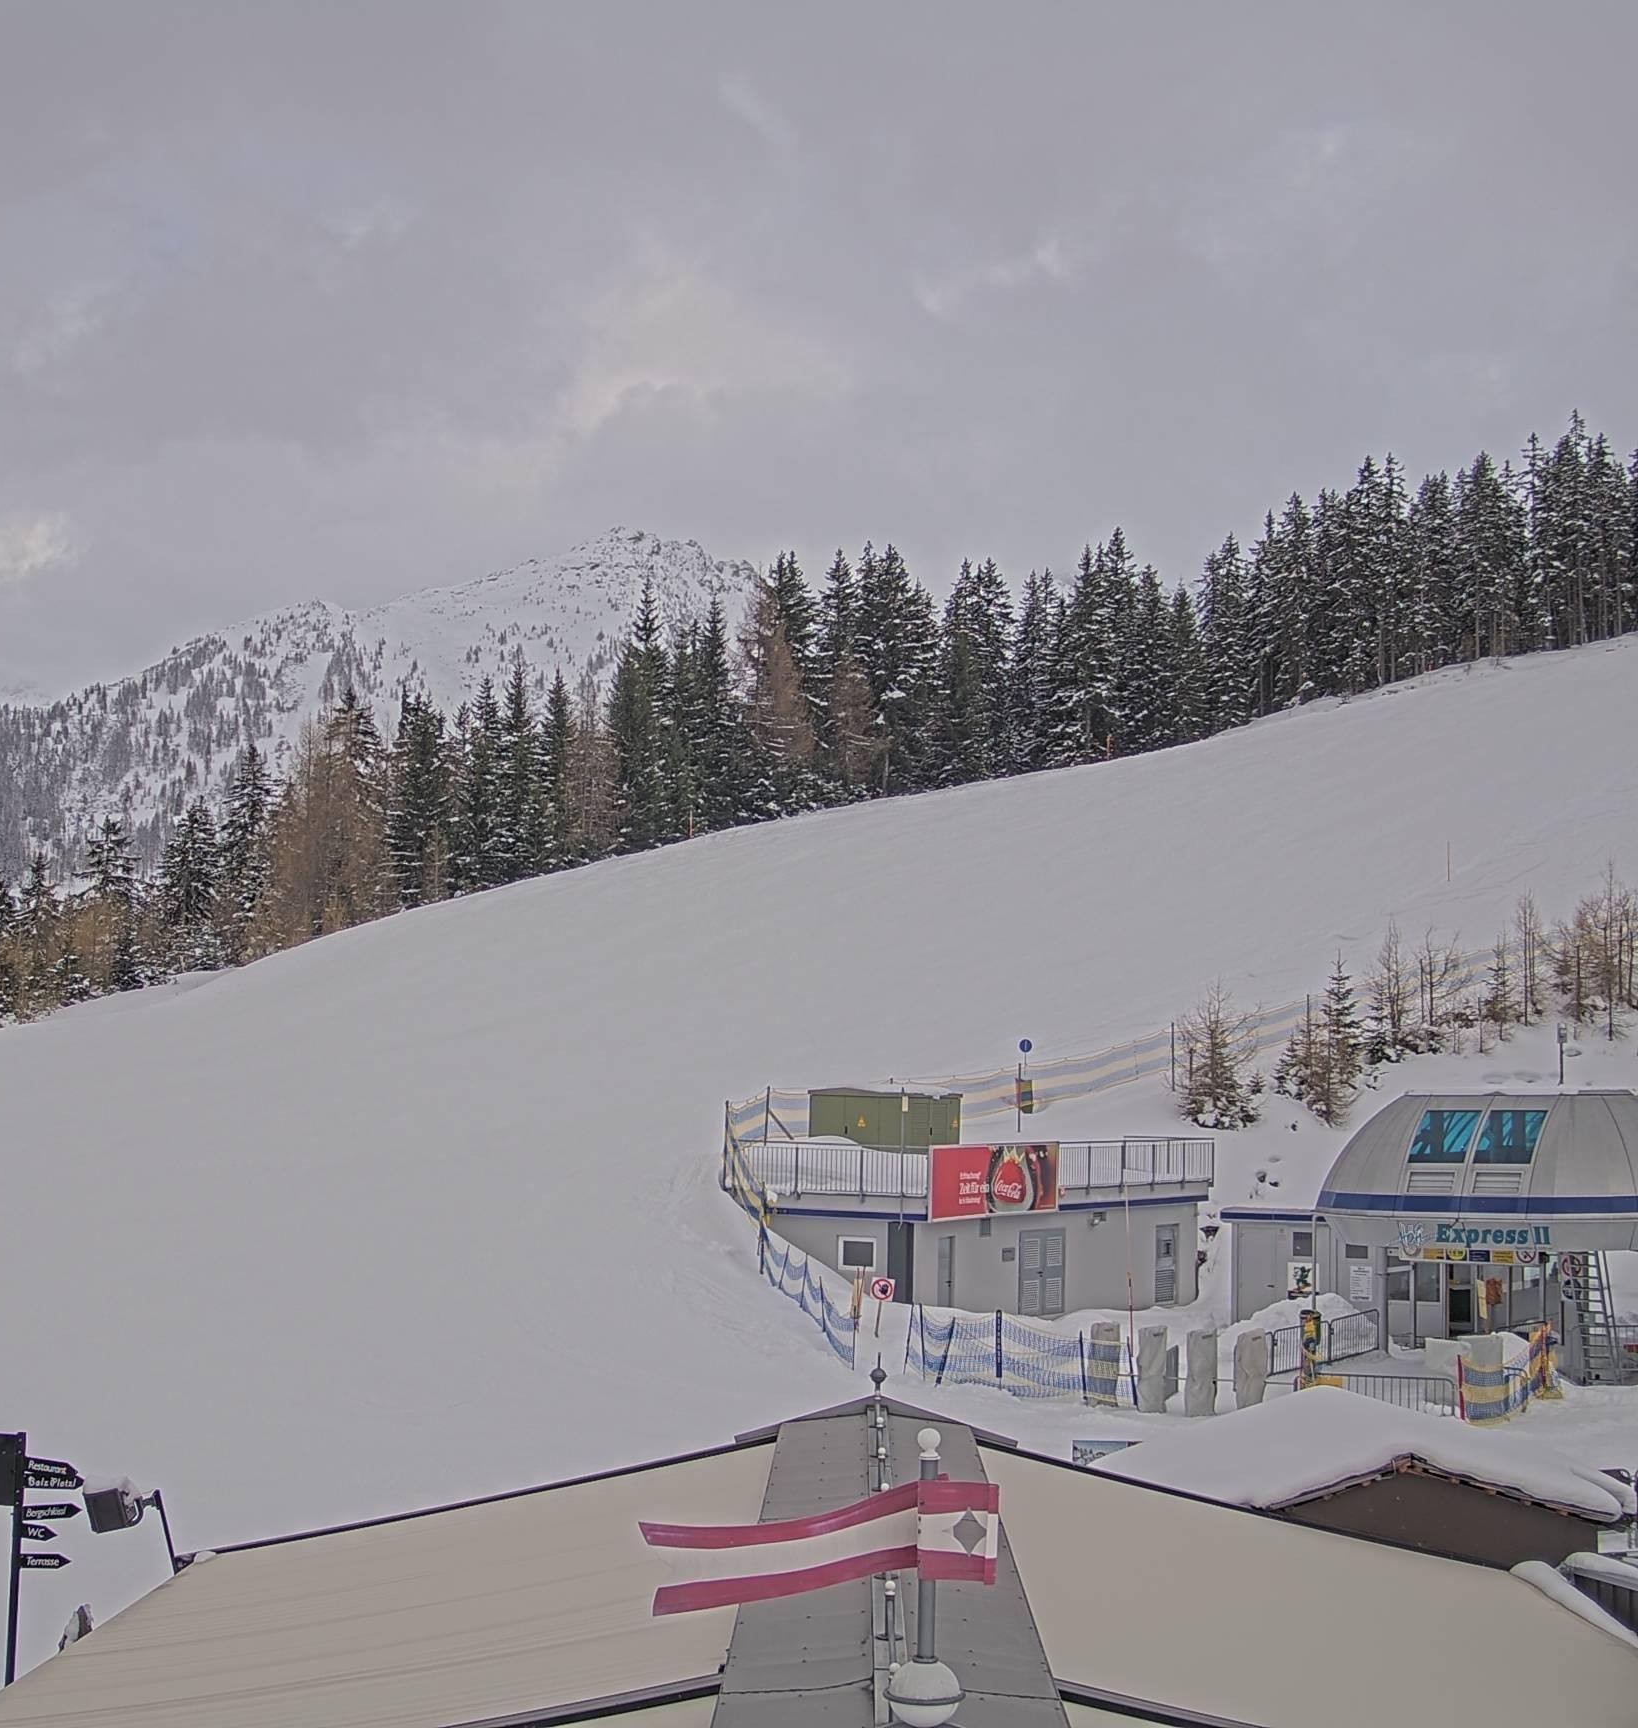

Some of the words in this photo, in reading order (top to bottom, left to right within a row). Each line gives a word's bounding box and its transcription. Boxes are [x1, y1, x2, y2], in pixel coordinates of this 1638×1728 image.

[1435, 1223, 1529, 1248] Express
[28, 1460, 67, 1476] Restaurant
[27, 1526, 46, 1538] WC
[26, 1555, 60, 1567] Terrasse
